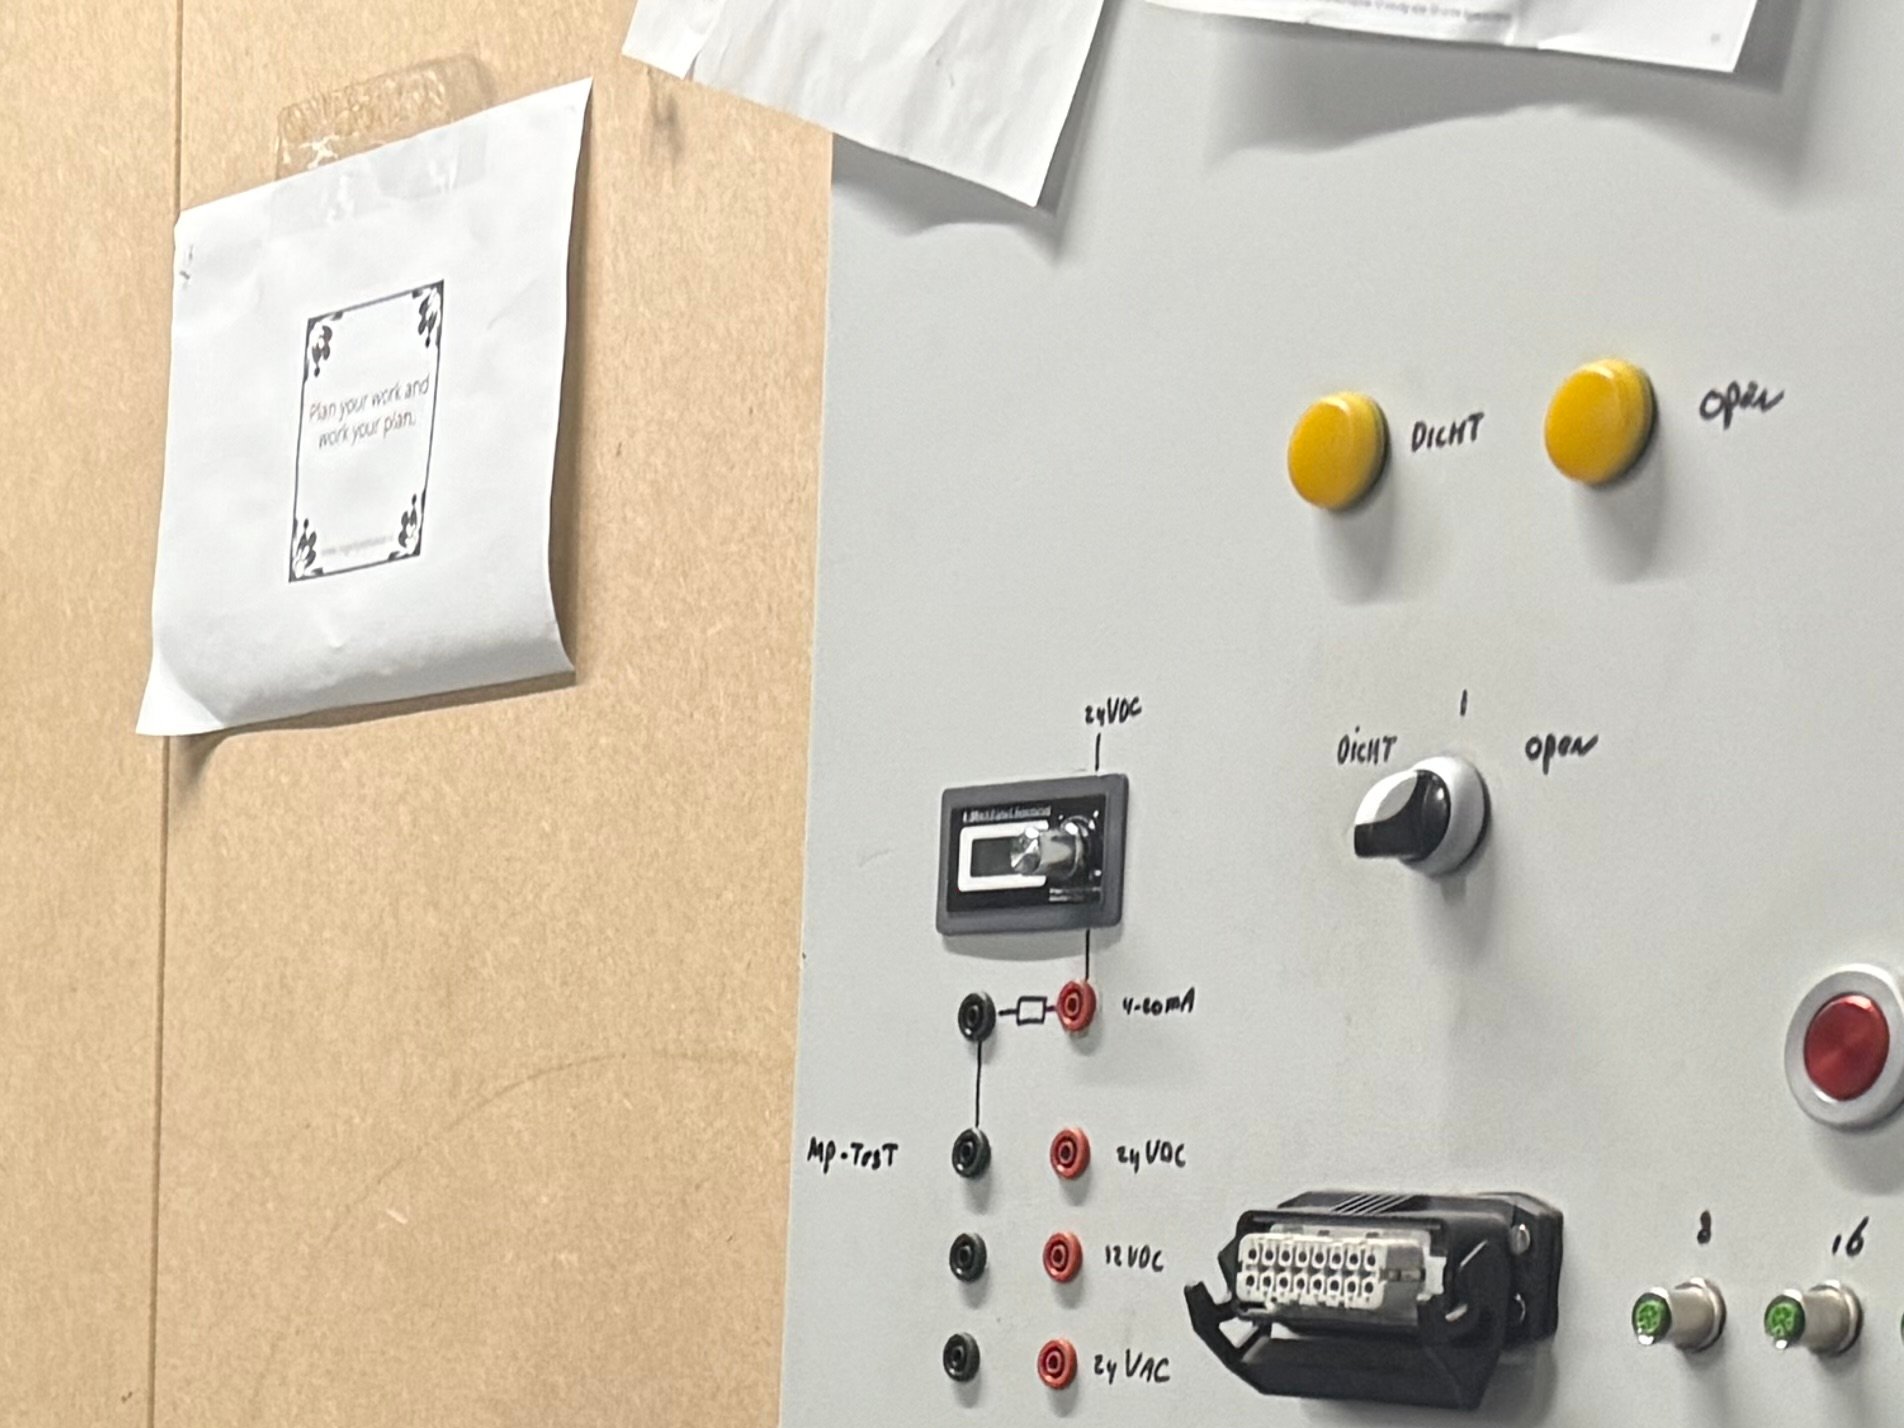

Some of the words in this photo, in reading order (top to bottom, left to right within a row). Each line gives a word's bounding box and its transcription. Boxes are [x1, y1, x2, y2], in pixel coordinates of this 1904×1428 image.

[309, 400, 337, 424] Plan
[339, 395, 368, 422] your
[372, 382, 401, 407] work
[405, 374, 430, 399] and
[318, 424, 348, 449] work
[351, 419, 381, 446] your
[1410, 412, 1485, 452] DICHT
[1831, 1214, 1870, 1258] 16
